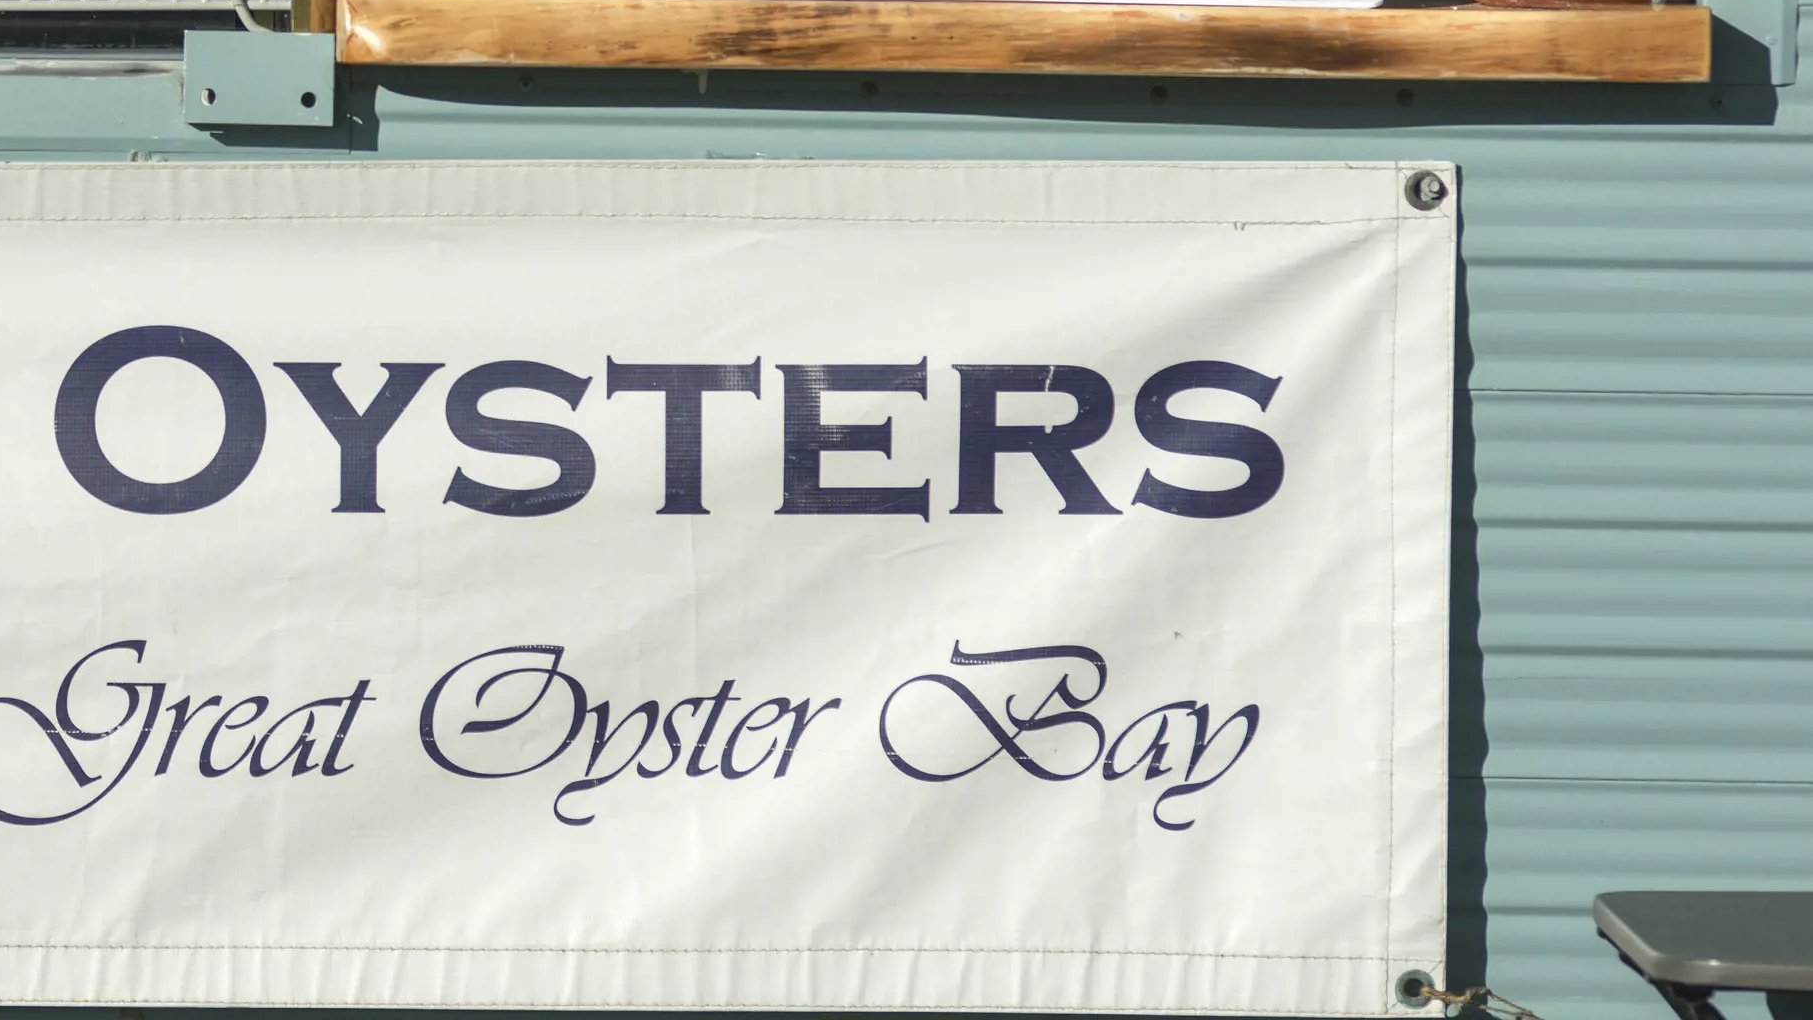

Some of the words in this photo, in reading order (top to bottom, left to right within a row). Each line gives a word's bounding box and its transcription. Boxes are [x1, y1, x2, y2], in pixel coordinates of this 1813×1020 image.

[55, 326, 1284, 523] OYSTERS
[418, 645, 841, 827] Oyster
[880, 640, 1260, 831] Bay
